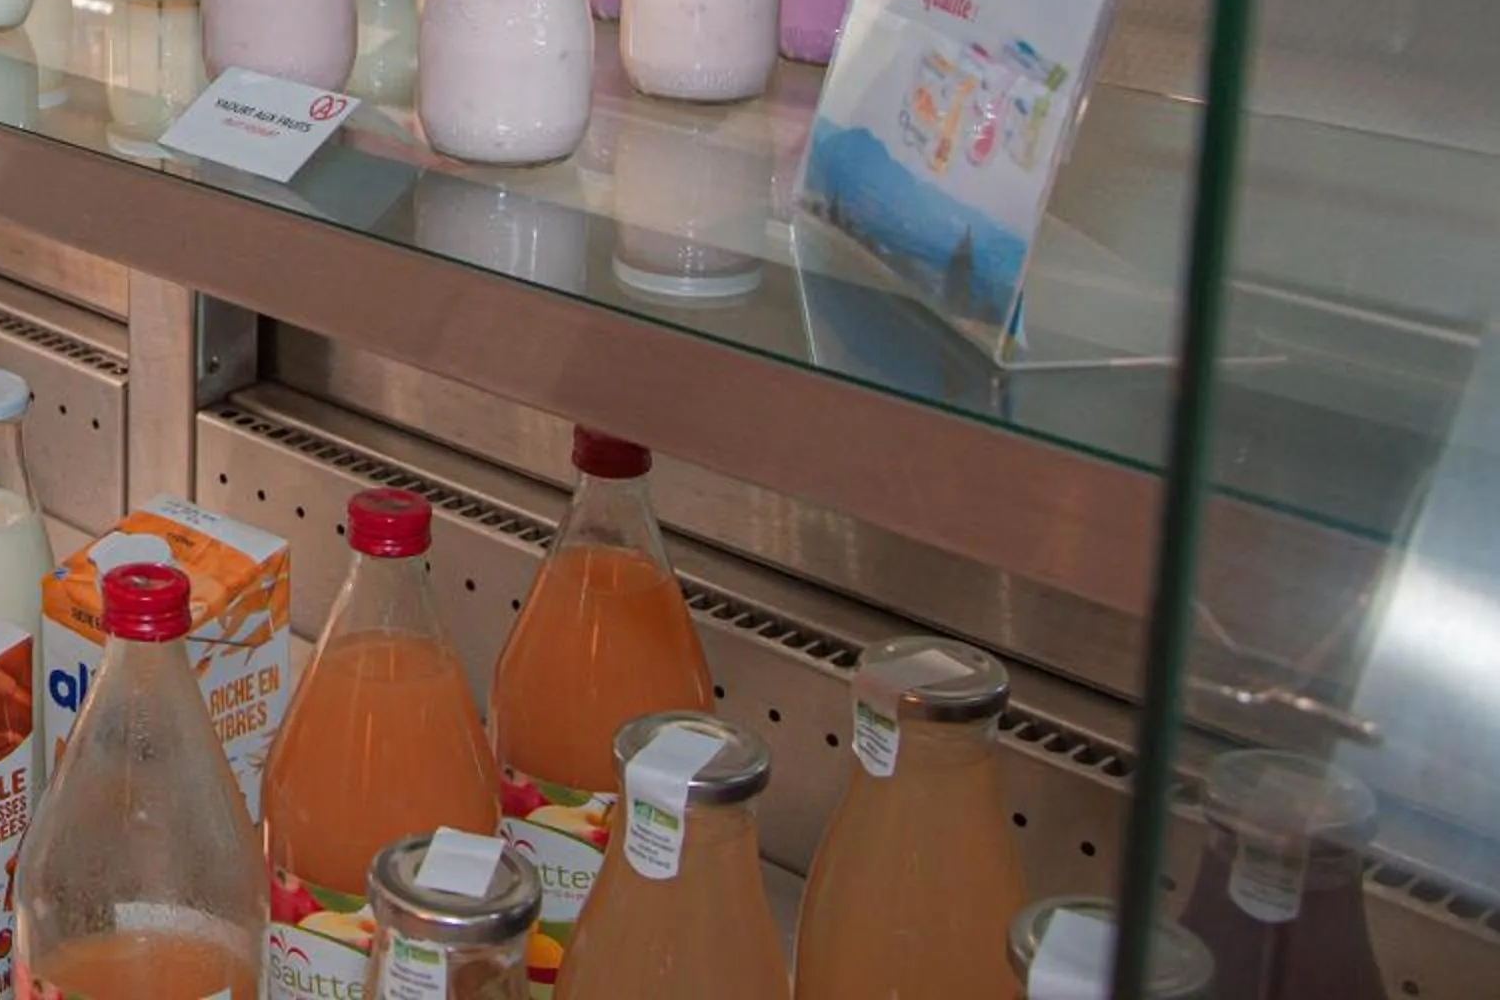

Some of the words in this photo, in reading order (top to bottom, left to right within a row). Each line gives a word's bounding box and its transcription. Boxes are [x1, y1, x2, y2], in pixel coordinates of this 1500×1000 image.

[210, 673, 255, 718] RICHE
[258, 664, 280, 697] EN
[270, 953, 366, 1000] Sautte
